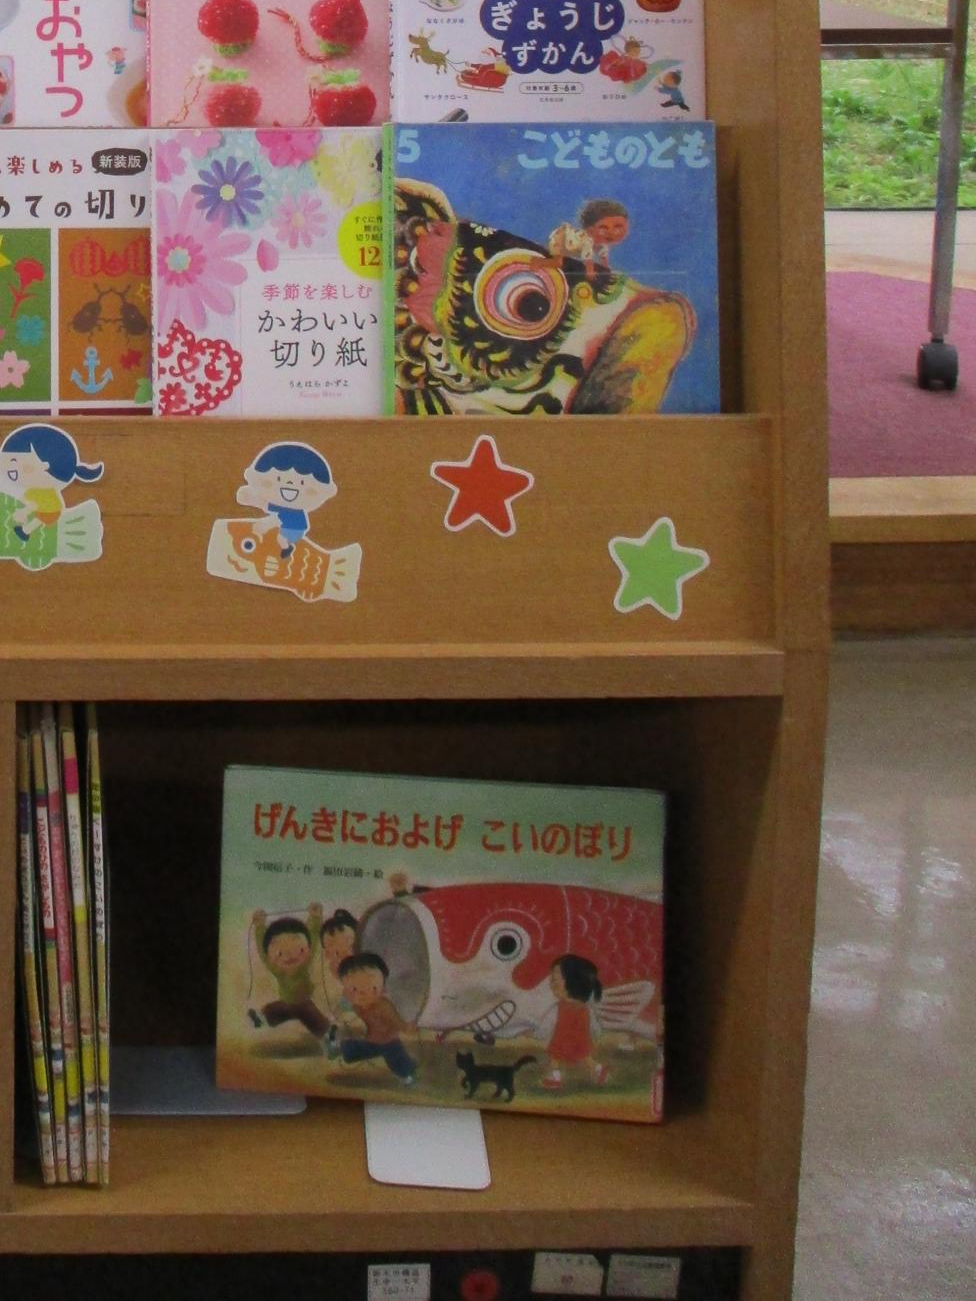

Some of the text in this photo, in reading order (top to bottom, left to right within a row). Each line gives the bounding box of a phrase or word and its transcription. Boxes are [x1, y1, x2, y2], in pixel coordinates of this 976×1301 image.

[490, 0, 615, 32] ぎょうじ
[511, 39, 595, 67] ずかん
[99, 154, 142, 170] 新装版
[396, 129, 421, 163] 5
[517, 130, 711, 169] こどものとも
[262, 283, 373, 302] 季節を楽しむ
[257, 308, 379, 333] かわいい
[269, 336, 369, 369] 切り紙
[253, 802, 633, 862] げんきにおよげ こいのぼり
